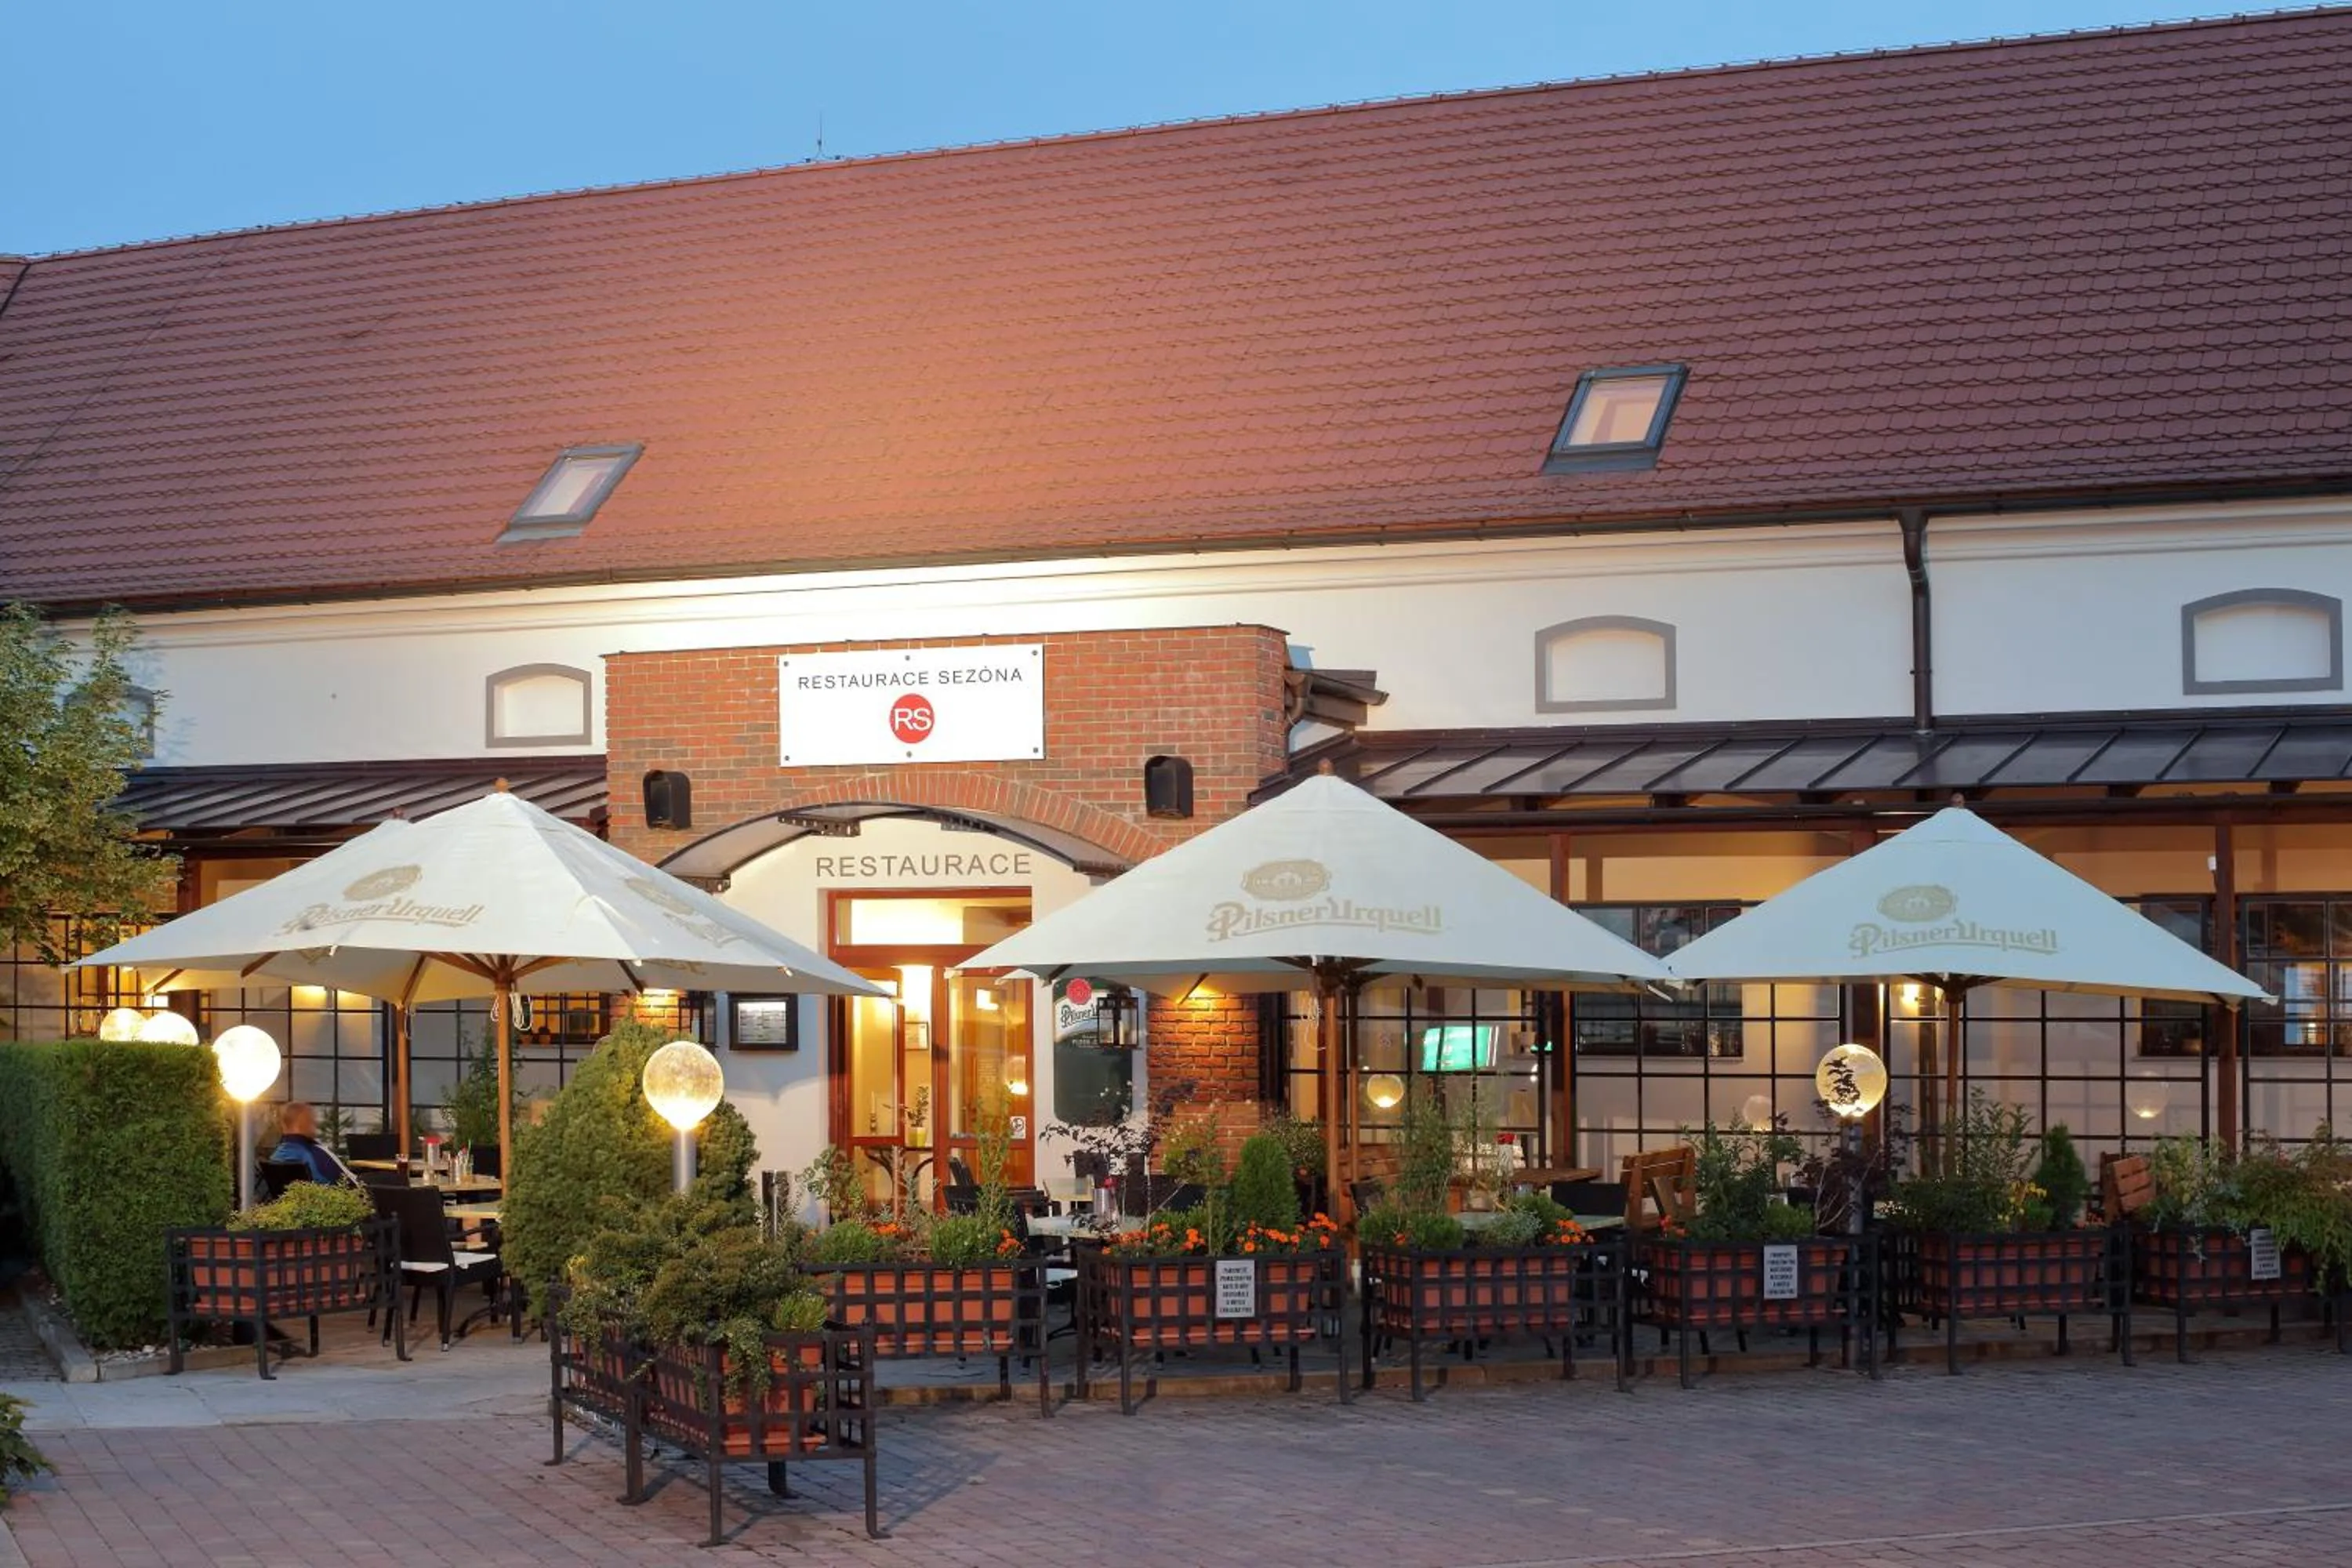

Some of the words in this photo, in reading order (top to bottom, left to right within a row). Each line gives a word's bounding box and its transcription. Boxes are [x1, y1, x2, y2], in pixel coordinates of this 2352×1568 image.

[798, 670, 929, 690] RESTAURACE
[938, 665, 1023, 684] SEZÓNA
[894, 707, 932, 731] RS
[815, 853, 1032, 877] RESTAURACE
[386, 898, 485, 926] Urquell
[1206, 901, 1327, 942] Pilsner
[1327, 896, 1442, 933] Urquell
[1848, 923, 1955, 959] Pilsner
[1954, 918, 2057, 951] Urquell
